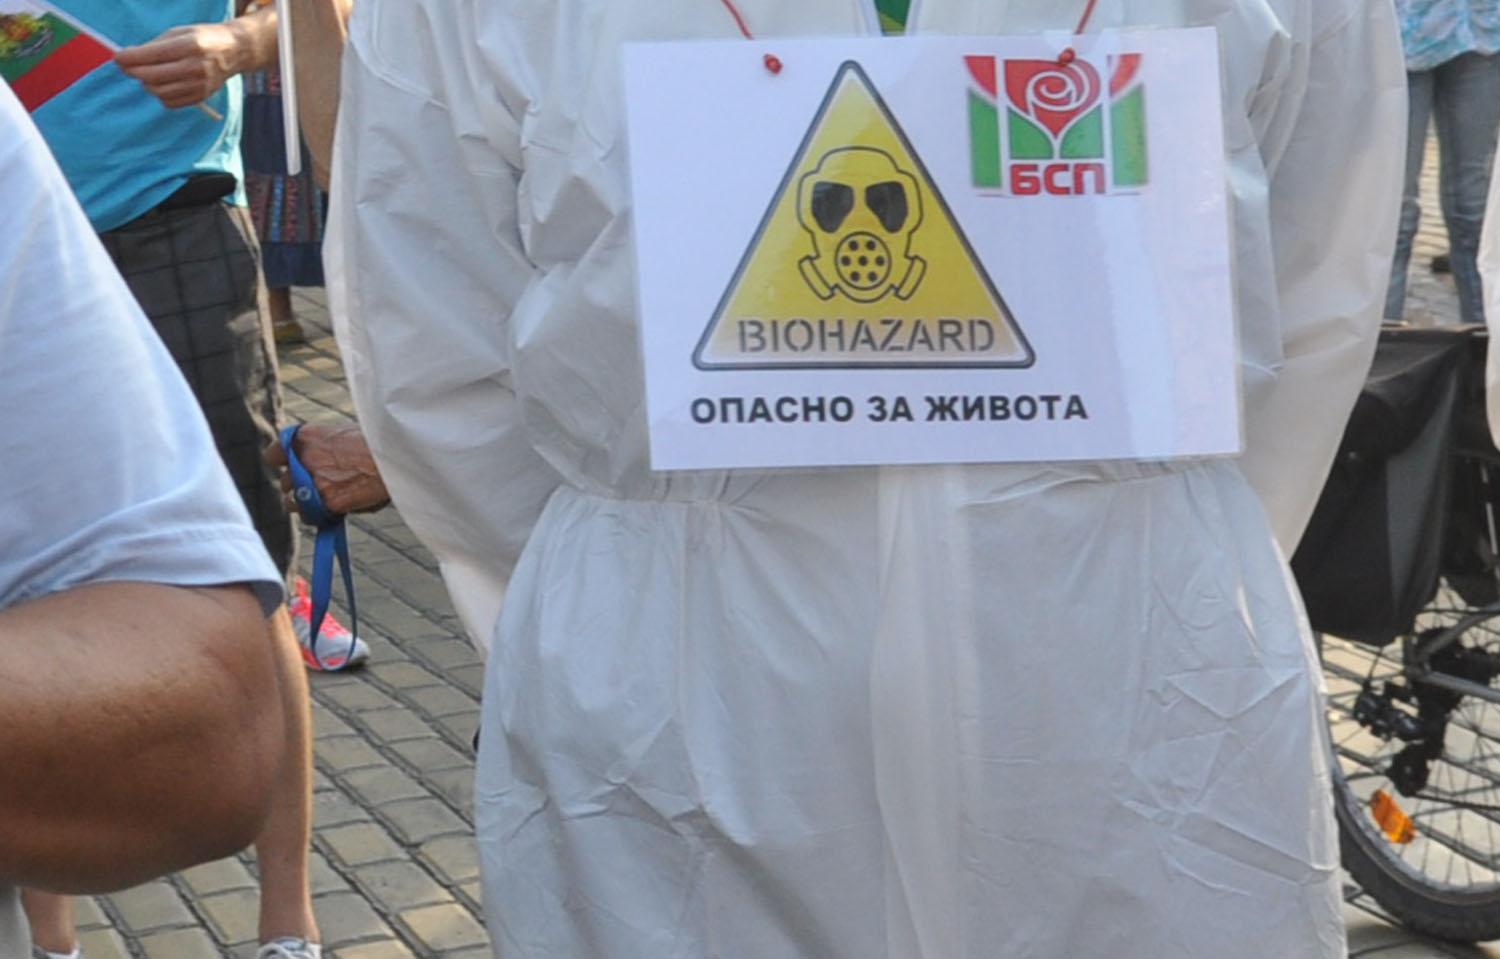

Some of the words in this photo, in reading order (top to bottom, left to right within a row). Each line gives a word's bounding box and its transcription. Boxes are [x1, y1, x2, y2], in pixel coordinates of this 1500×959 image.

[1009, 163, 1106, 196] БСП
[738, 318, 996, 353] BIOHAZARD
[690, 395, 854, 424] ОПАСНО
[867, 395, 915, 424] ЗА
[924, 394, 1089, 422] ЖИВОТА
